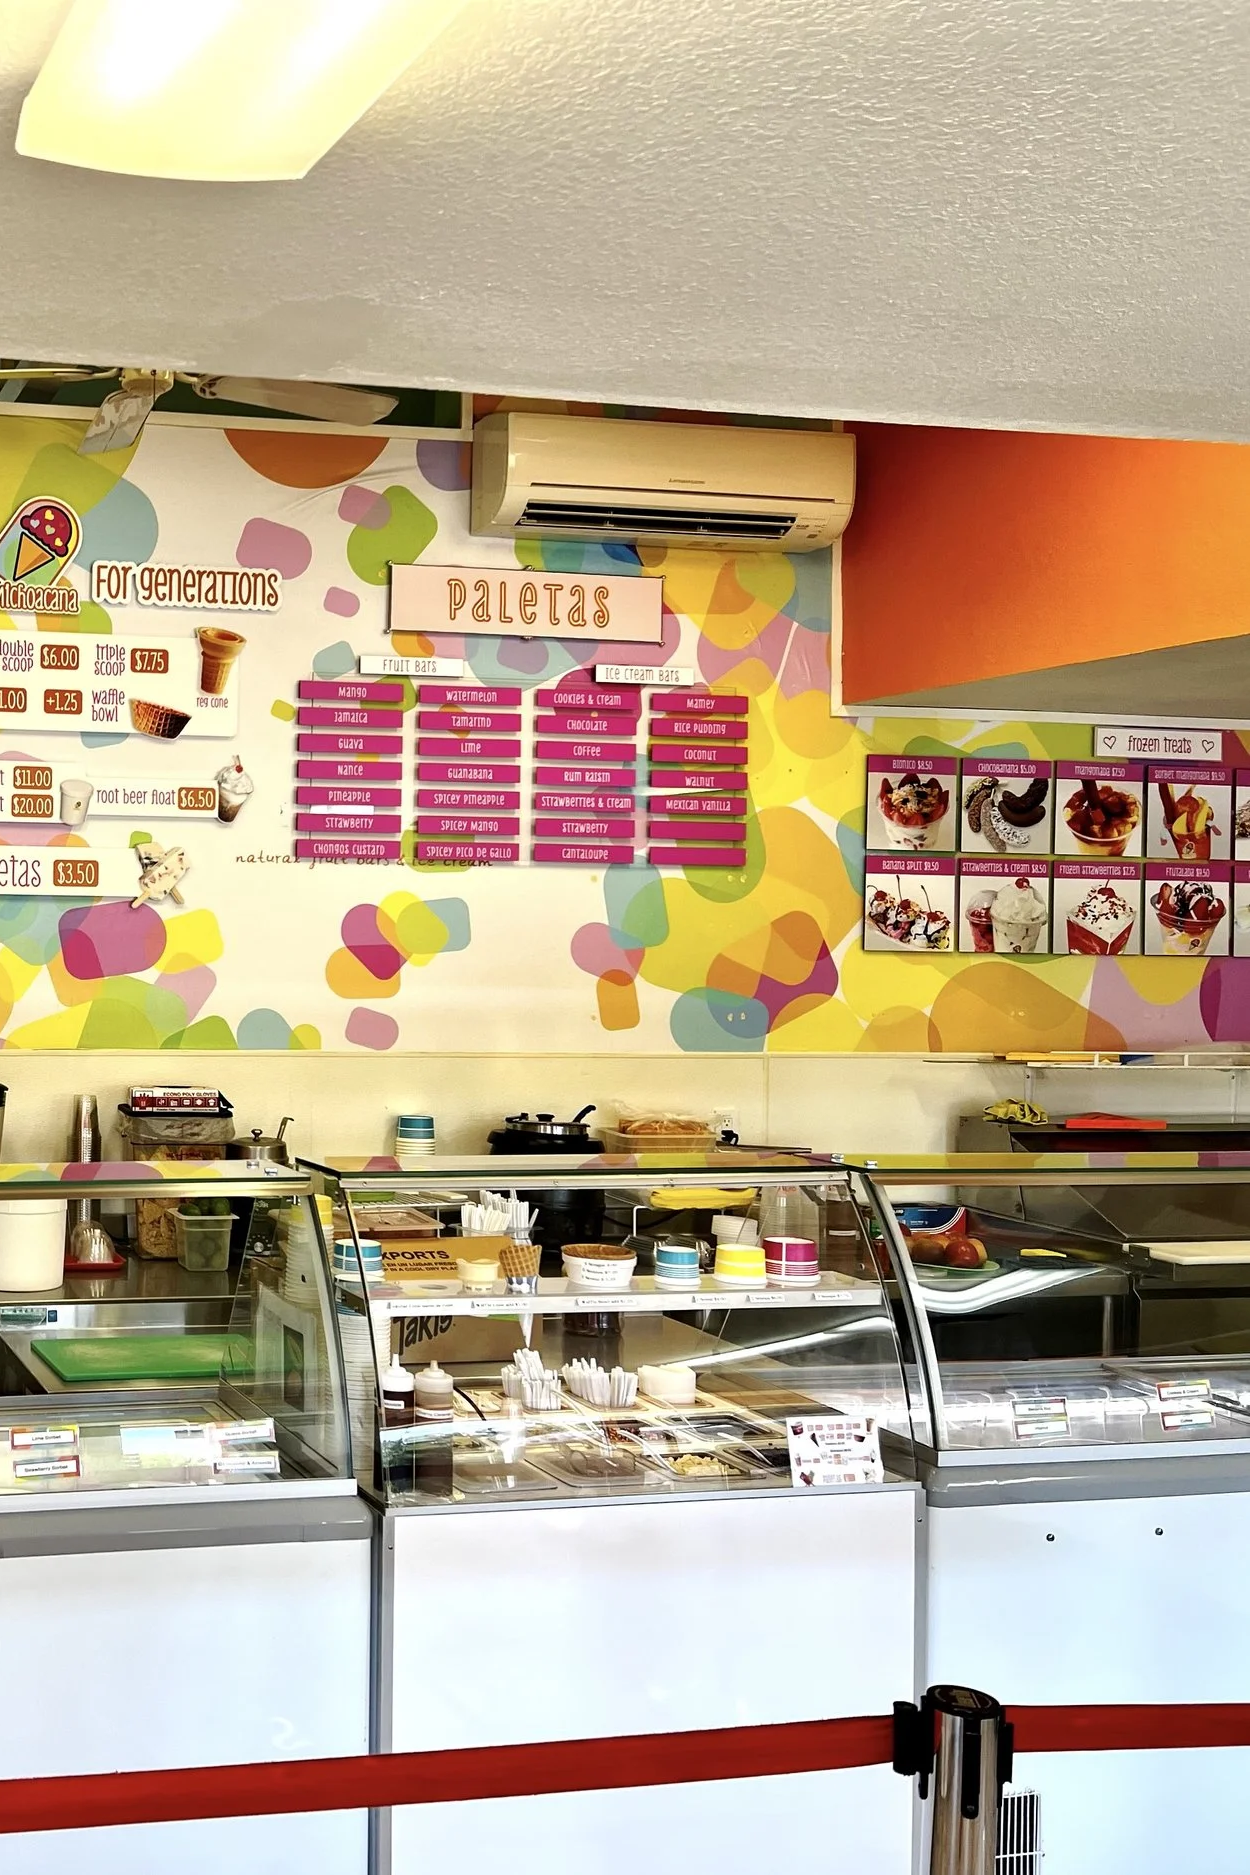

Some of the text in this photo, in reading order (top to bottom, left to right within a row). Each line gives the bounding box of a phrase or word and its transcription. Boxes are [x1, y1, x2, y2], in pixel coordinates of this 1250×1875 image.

[43, 647, 78, 667] $6.00
[135, 651, 164, 671] $7.75
[47, 692, 78, 711] +1.25
[588, 695, 593, 704] &
[15, 769, 51, 787] $11.00
[13, 797, 52, 815] $20.00
[181, 790, 214, 808] $6.50
[598, 797, 603, 807] &
[57, 862, 95, 885] $3.50
